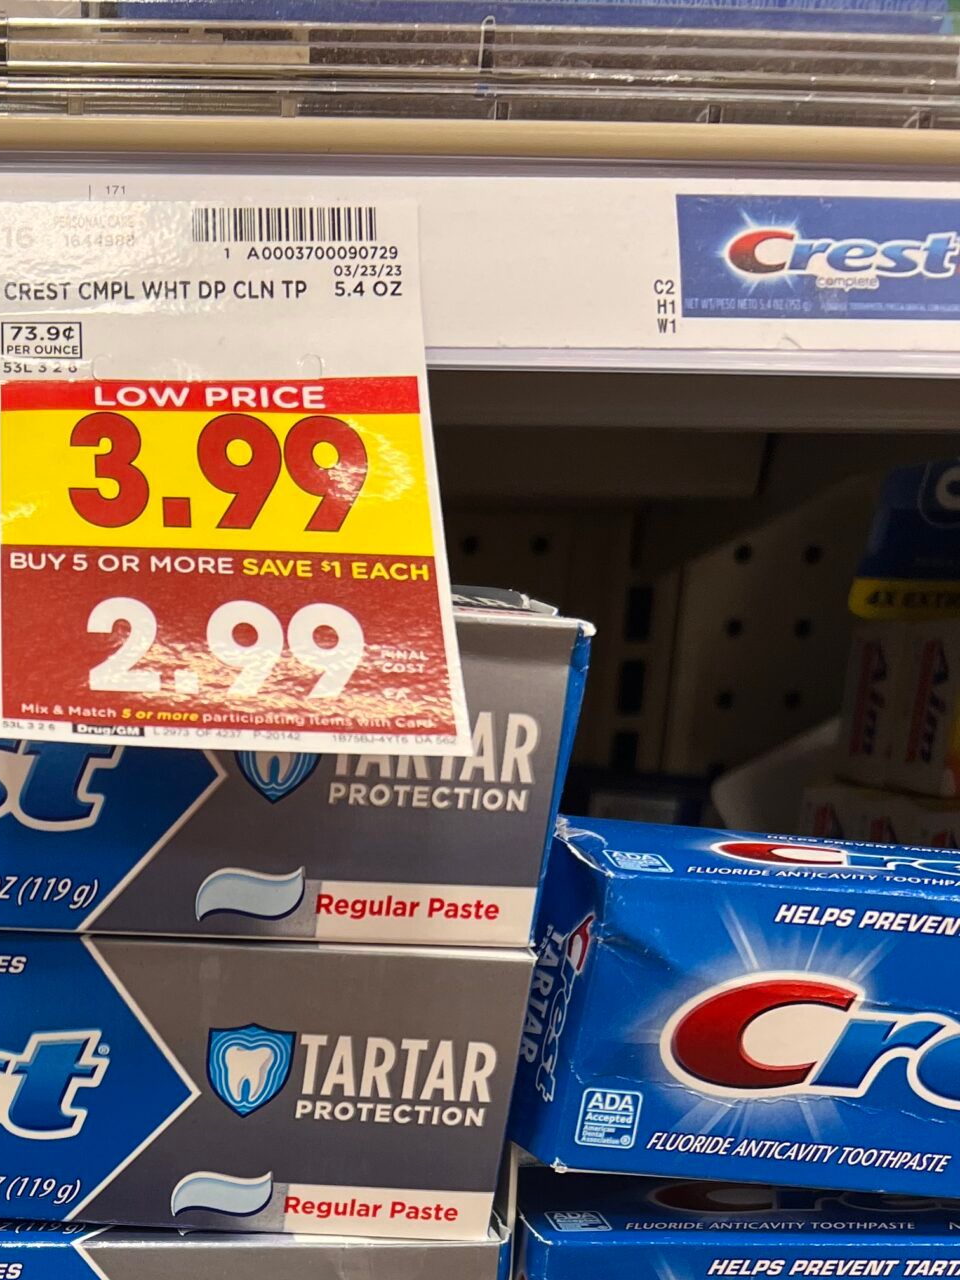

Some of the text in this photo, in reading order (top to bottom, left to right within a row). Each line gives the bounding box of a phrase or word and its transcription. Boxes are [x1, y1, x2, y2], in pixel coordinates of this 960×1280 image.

[105, 186, 126, 195] 171
[246, 246, 399, 260] A0003700090729
[725, 227, 959, 278] Crest
[334, 264, 402, 277] 03/23/23
[4, 281, 308, 301] CREST CMPL WHT DP CLN TP
[334, 281, 402, 297] 5.4 OZ
[654, 280, 675, 295] C2
[817, 277, 879, 290] complete
[657, 300, 676, 314] H1
[10, 325, 75, 343] 73.9¢
[657, 319, 677, 333] W1
[7, 344, 79, 356] PER OUNCE
[94, 385, 327, 410] LOW PRICE
[68, 411, 368, 532] 3.99
[10, 552, 66, 571] BUY
[72, 554, 88, 572] 5
[97, 555, 140, 573] OR
[150, 555, 234, 575] MORE
[242, 558, 313, 578] SAVE
[321, 559, 341, 579] $1
[351, 560, 430, 581] EACH
[86, 596, 365, 699] 2.99
[21, 703, 199, 722] Mix & Match 5 or more
[17, 876, 72, 906] (119
[68, 879, 100, 910] g)
[316, 894, 500, 921] Regular Paste
[299, 1033, 497, 1104] TARTAR
[295, 1100, 486, 1127] PROTECTION
